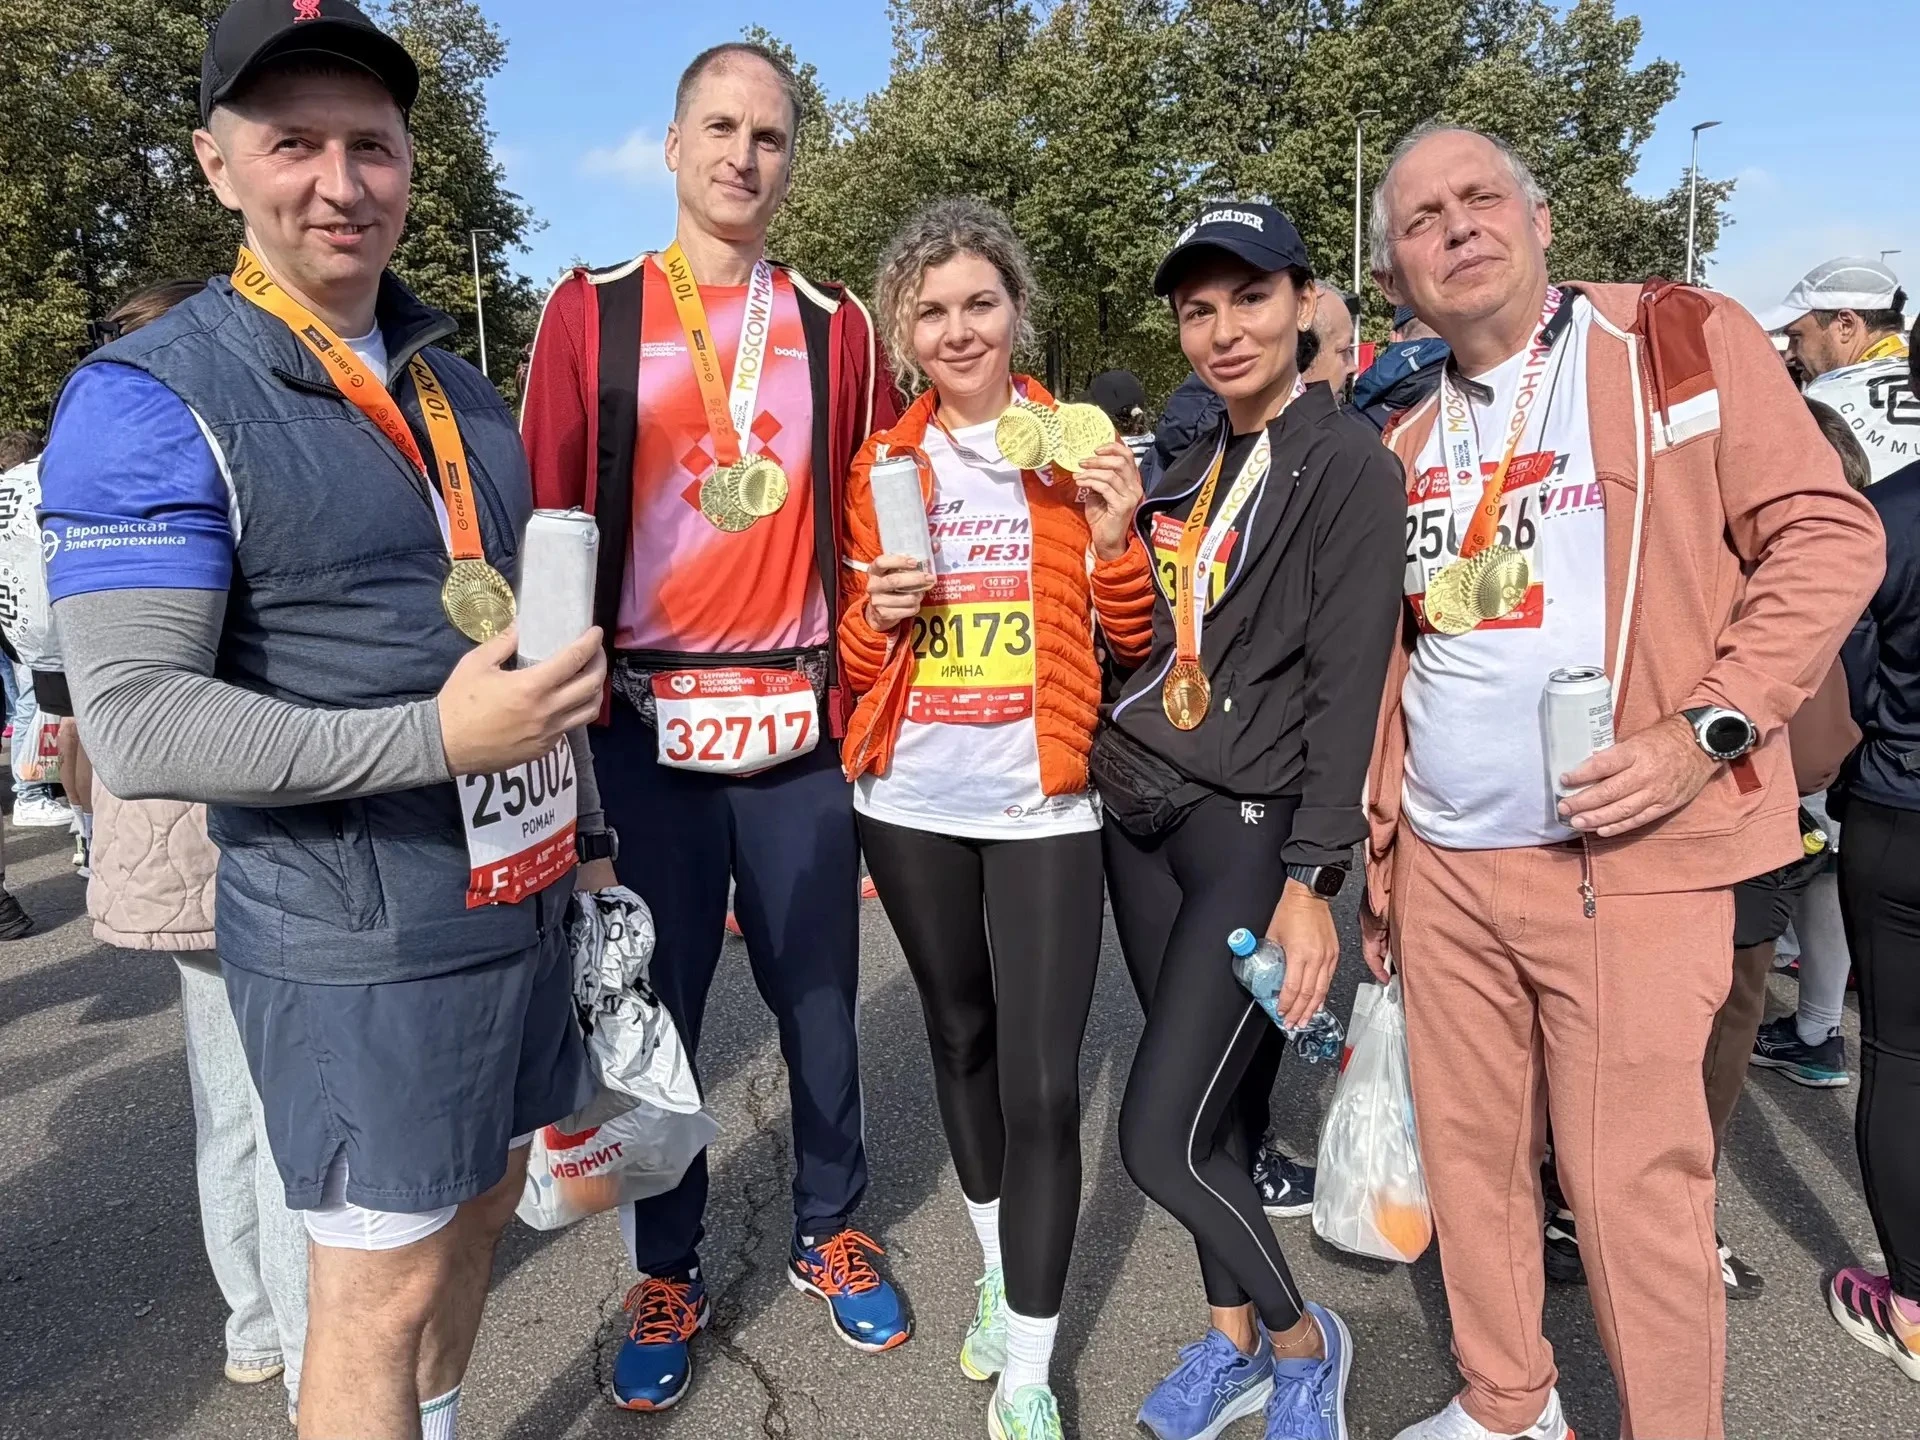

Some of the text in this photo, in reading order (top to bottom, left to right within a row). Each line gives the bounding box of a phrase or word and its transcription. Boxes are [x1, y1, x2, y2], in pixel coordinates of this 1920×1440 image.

[233, 253, 275, 296] 10 K
[668, 257, 693, 302] 10 KM
[328, 349, 355, 375] SBER
[736, 302, 768, 391] MOSCOW
[414, 362, 448, 421] 10 KM
[453, 491, 464, 518] СБЕР
[1188, 479, 1215, 532] 10 KM
[64, 535, 187, 551] Электротехника
[66, 522, 168, 539] Европейская
[912, 611, 1032, 659] 28173
[941, 665, 985, 678] ИРИНА
[666, 711, 812, 762] 32717
[465, 734, 574, 829] 25002
[521, 808, 556, 839] РОМАН
